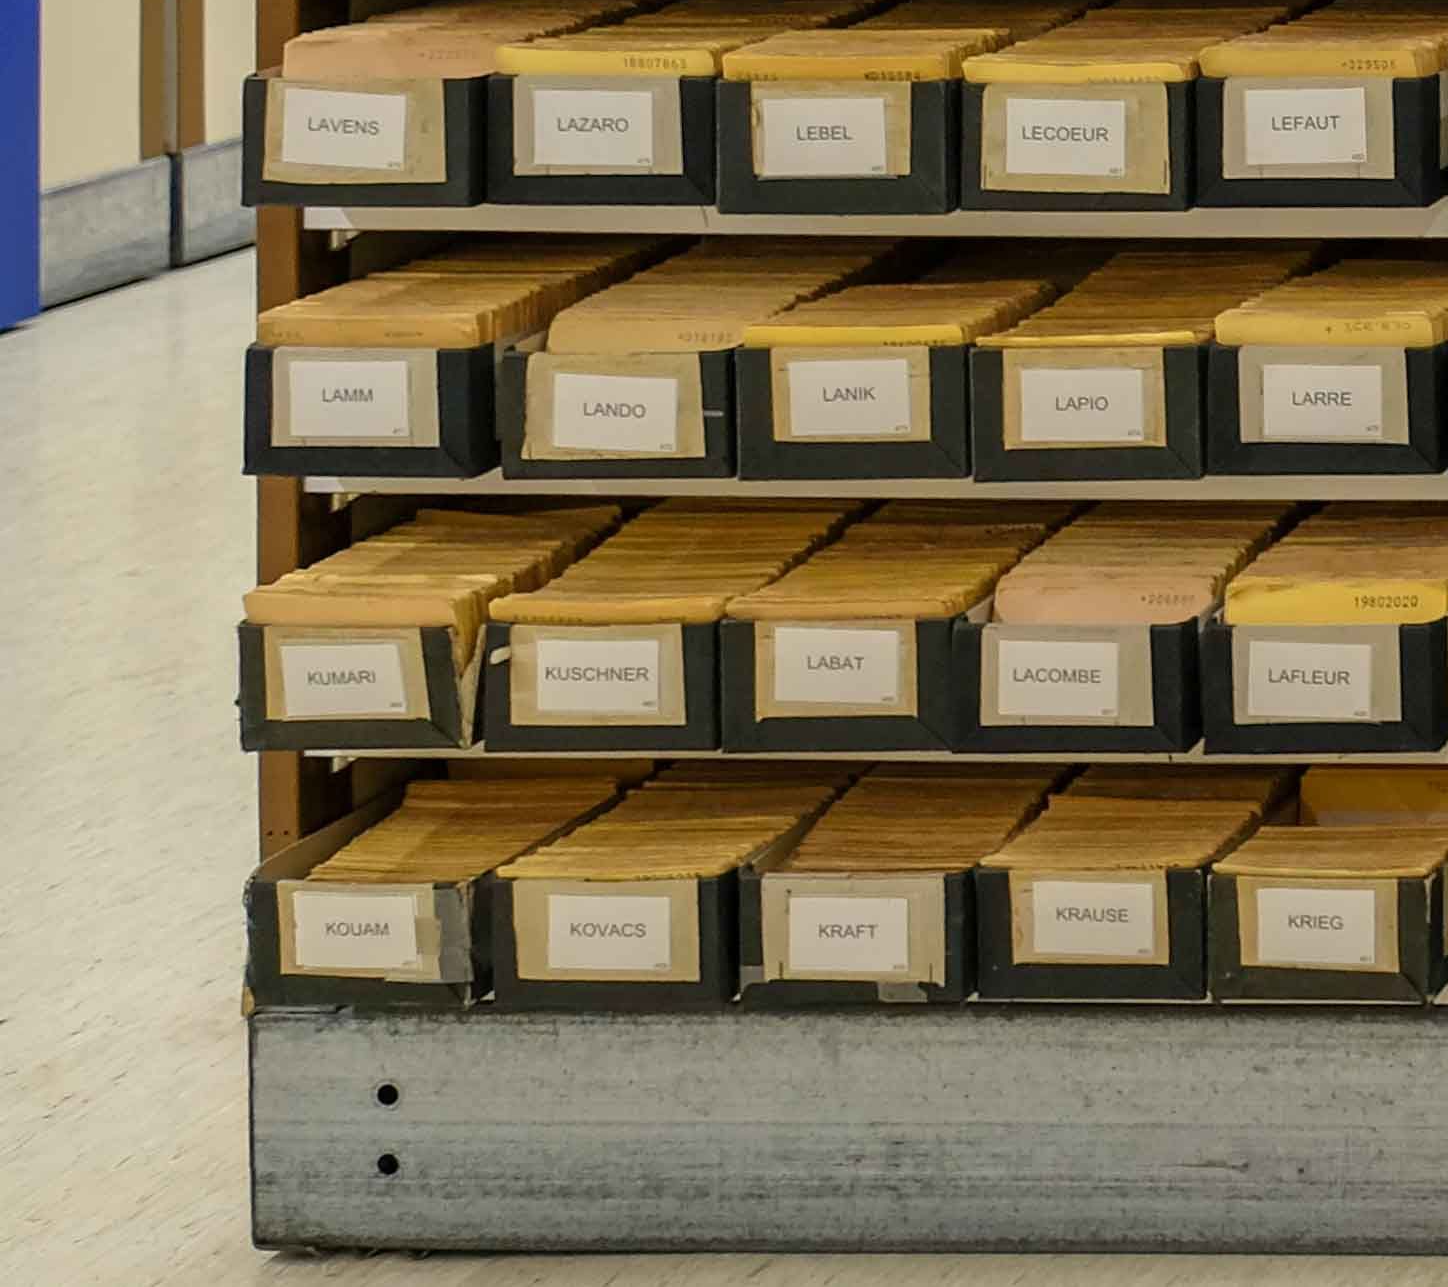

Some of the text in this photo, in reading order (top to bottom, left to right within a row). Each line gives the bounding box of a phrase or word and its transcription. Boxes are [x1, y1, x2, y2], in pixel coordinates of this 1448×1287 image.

[796, 125, 853, 142] LEBEL
[822, 386, 876, 403] LANIK
[1292, 391, 1353, 407] LARRE
[544, 666, 649, 683] KUSCHNER
[818, 923, 879, 939] KRAFT
[1287, 914, 1345, 931] KRIEG
